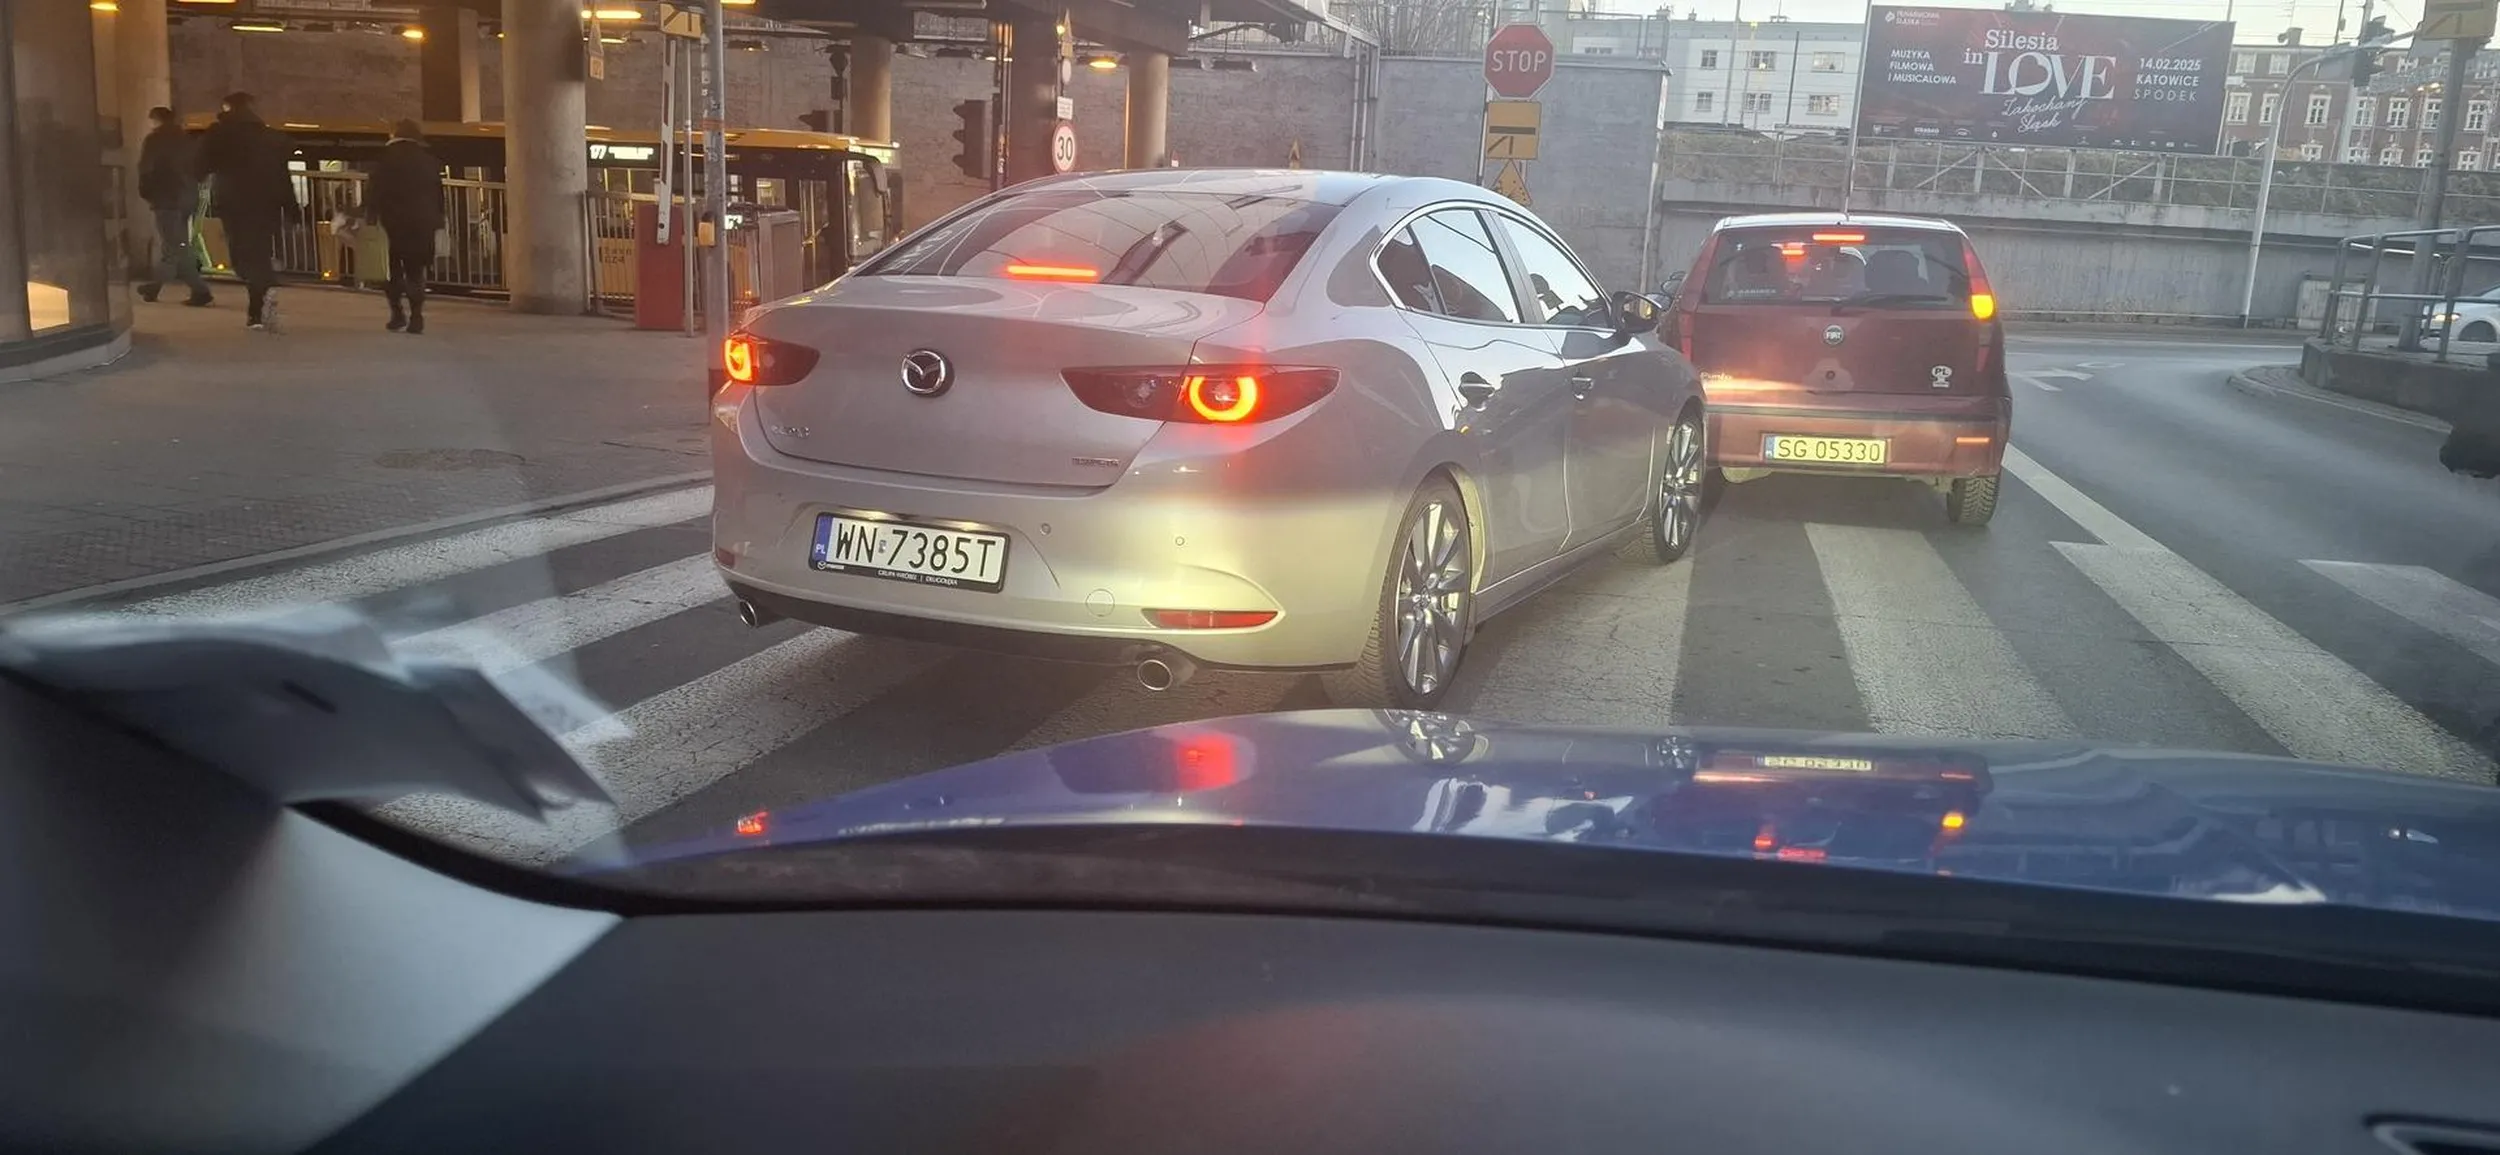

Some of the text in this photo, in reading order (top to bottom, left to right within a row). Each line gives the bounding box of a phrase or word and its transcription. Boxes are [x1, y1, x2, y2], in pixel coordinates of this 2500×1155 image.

[1985, 29, 2059, 51] Silesia
[1491, 50, 1547, 72] STOP
[1890, 49, 1931, 60] MUZYKA
[1889, 60, 1934, 71] FILMOWA
[2140, 57, 2201, 71] 14.02.2025
[1963, 48, 2116, 100] in LOVE
[2136, 74, 2200, 86] KATOWICE
[2133, 88, 2197, 101] SPODEK
[1057, 136, 1074, 161] 30
[1778, 439, 1880, 461] SG 05330
[815, 543, 826, 555] PL
[835, 522, 996, 577] WN 7385T
